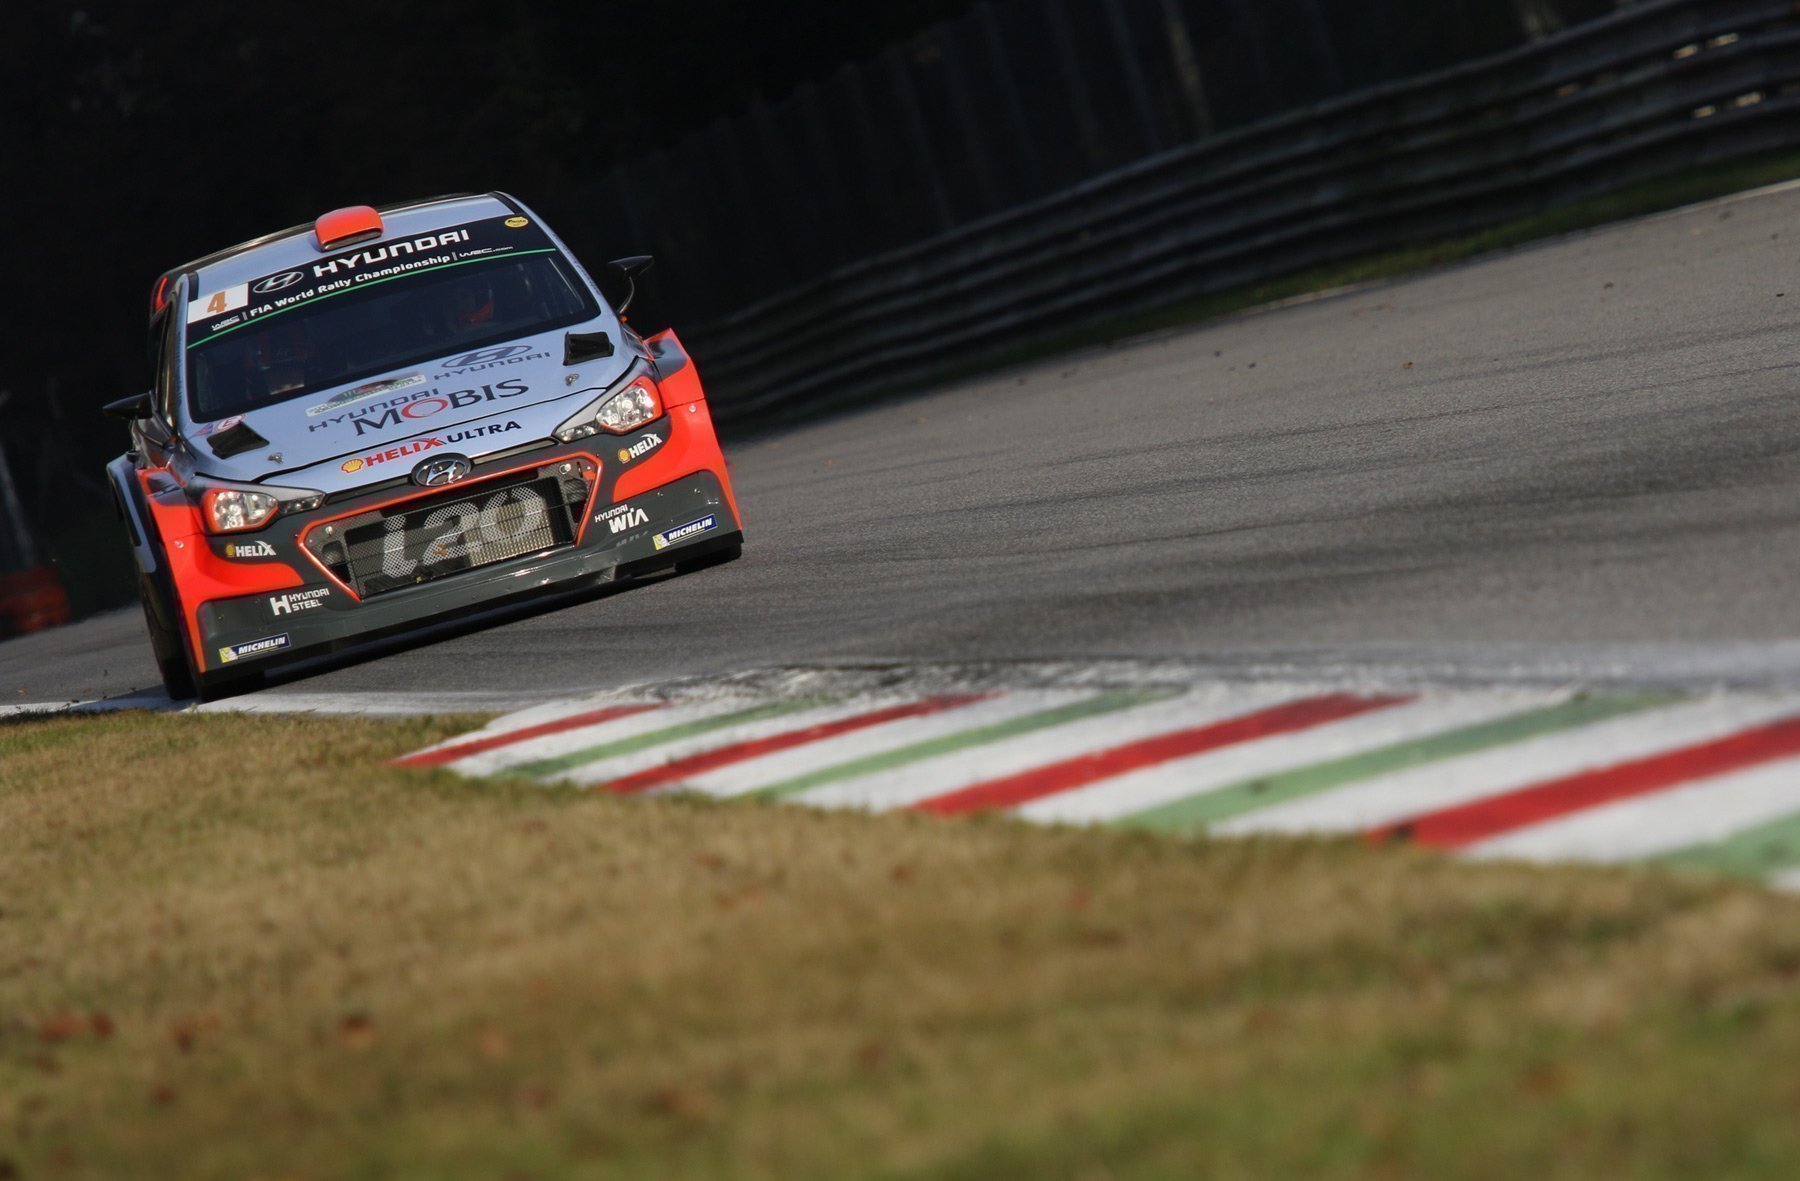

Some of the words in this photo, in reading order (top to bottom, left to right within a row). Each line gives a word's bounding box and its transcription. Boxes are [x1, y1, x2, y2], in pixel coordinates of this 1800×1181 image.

[313, 229, 470, 278] HYUNDAI
[250, 304, 273, 317] FIA
[275, 289, 314, 307] World
[317, 278, 352, 294] Rally
[355, 254, 450, 282] Championship
[207, 291, 227, 313] 4
[433, 352, 550, 380] HYUNDAI
[308, 388, 440, 433] HYUNDAI
[352, 378, 529, 436] MOBIS
[365, 437, 447, 467] HELIX
[446, 420, 522, 443] ULTRA
[629, 432, 663, 459] HELIX
[594, 503, 629, 523] HYUNDAI
[668, 518, 713, 541] MICHELIN
[235, 540, 277, 557] HELIX
[288, 588, 330, 602] HYUNDAI
[291, 599, 323, 611] STEEL
[238, 636, 286, 654] MICHELIN
